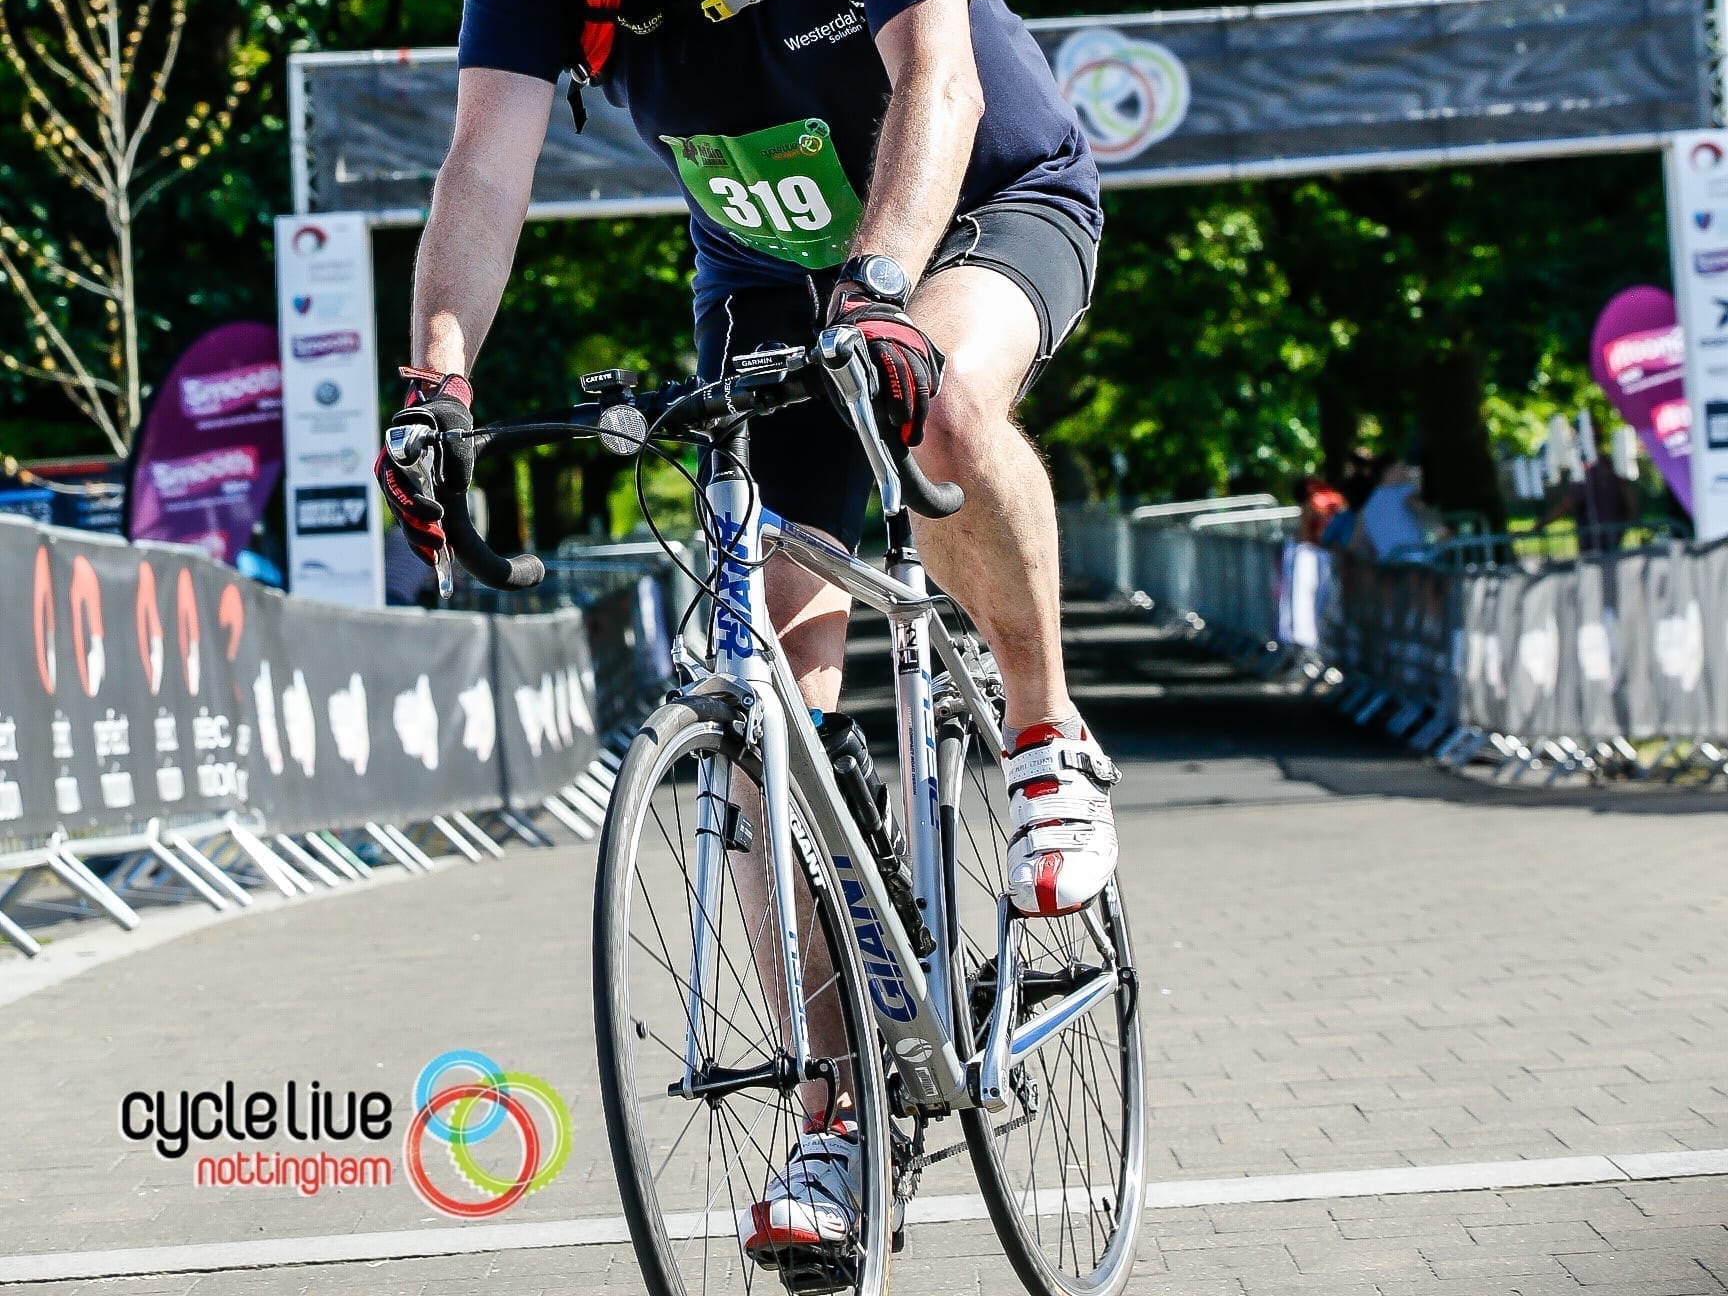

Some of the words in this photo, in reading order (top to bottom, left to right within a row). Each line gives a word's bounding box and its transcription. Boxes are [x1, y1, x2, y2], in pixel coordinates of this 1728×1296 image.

[708, 175, 832, 232] 319
[741, 357, 773, 367] GARMIN
[585, 372, 613, 384] CATEYE
